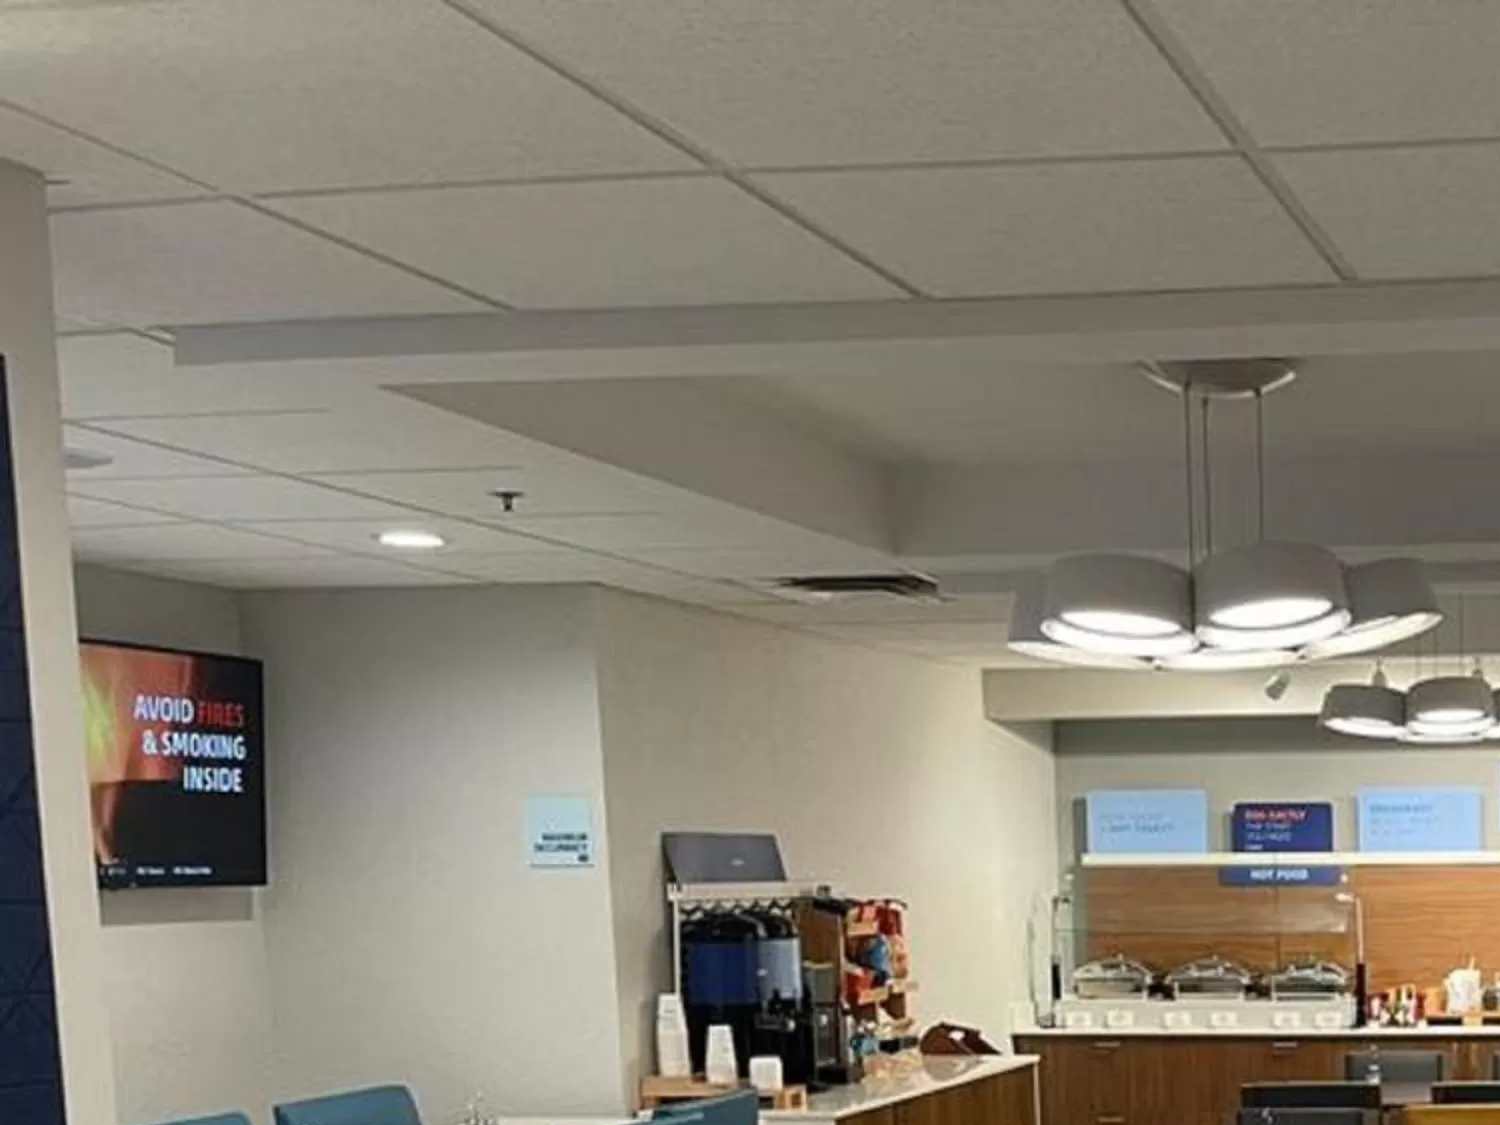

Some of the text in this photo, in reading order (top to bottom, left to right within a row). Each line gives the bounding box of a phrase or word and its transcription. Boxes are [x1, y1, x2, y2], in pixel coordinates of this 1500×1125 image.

[134, 695, 245, 727] AVOID FIRES
[142, 729, 247, 761] & SMOKING
[183, 766, 243, 793] INSIDE
[1250, 868, 1310, 880] HOT FOOD
